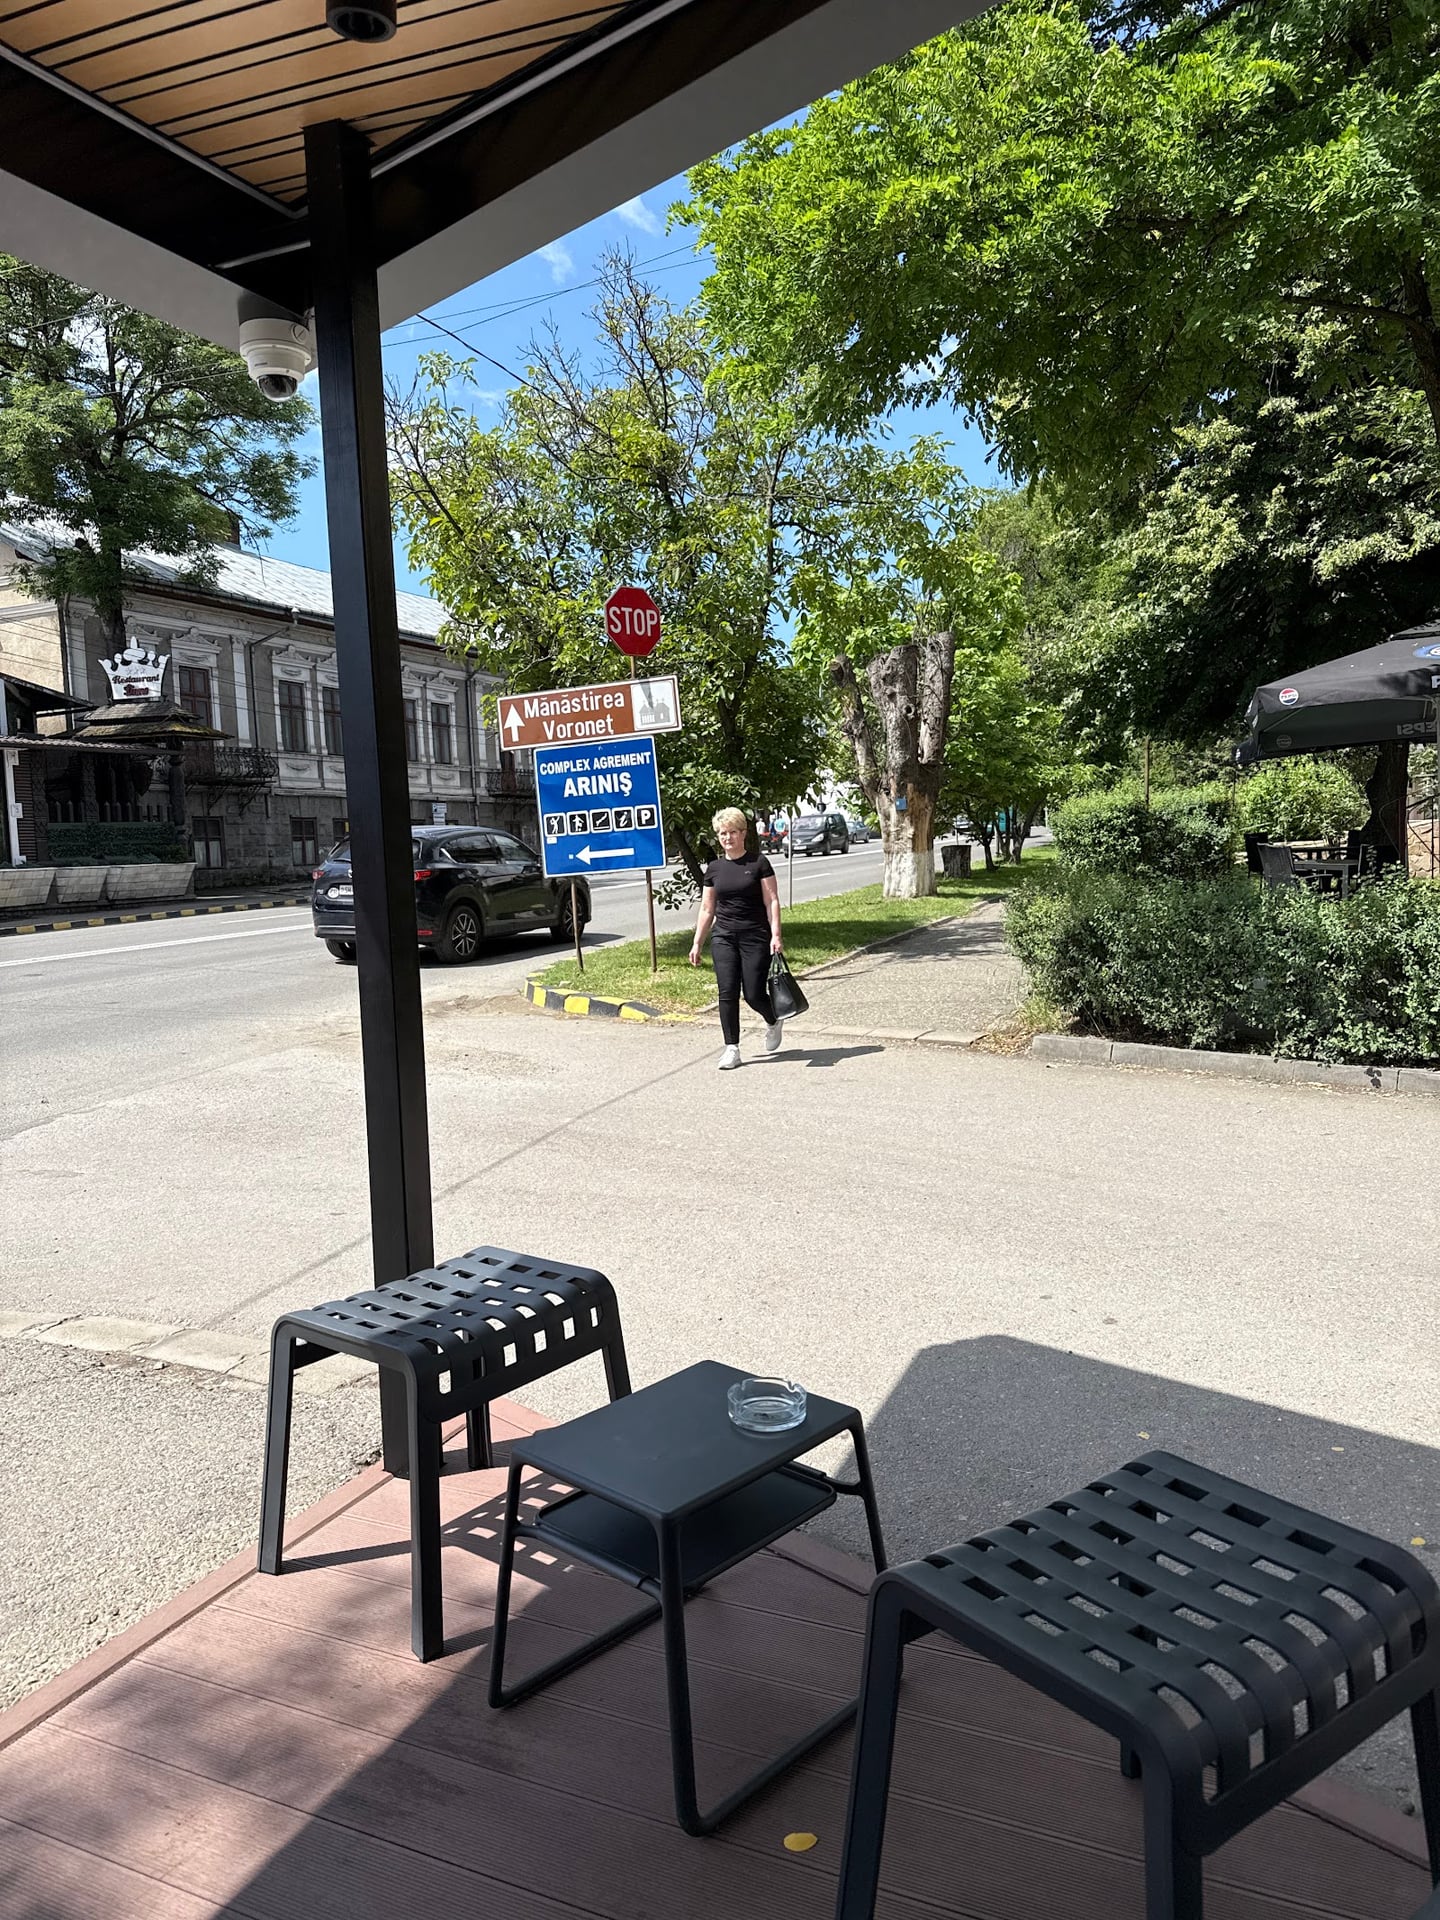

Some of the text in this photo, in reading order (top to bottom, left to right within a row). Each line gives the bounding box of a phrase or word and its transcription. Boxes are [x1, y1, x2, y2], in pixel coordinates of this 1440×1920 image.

[609, 606, 658, 637] STOP
[523, 691, 625, 719] Mănăstirea
[539, 751, 651, 775] COMPLEX AGREMENT
